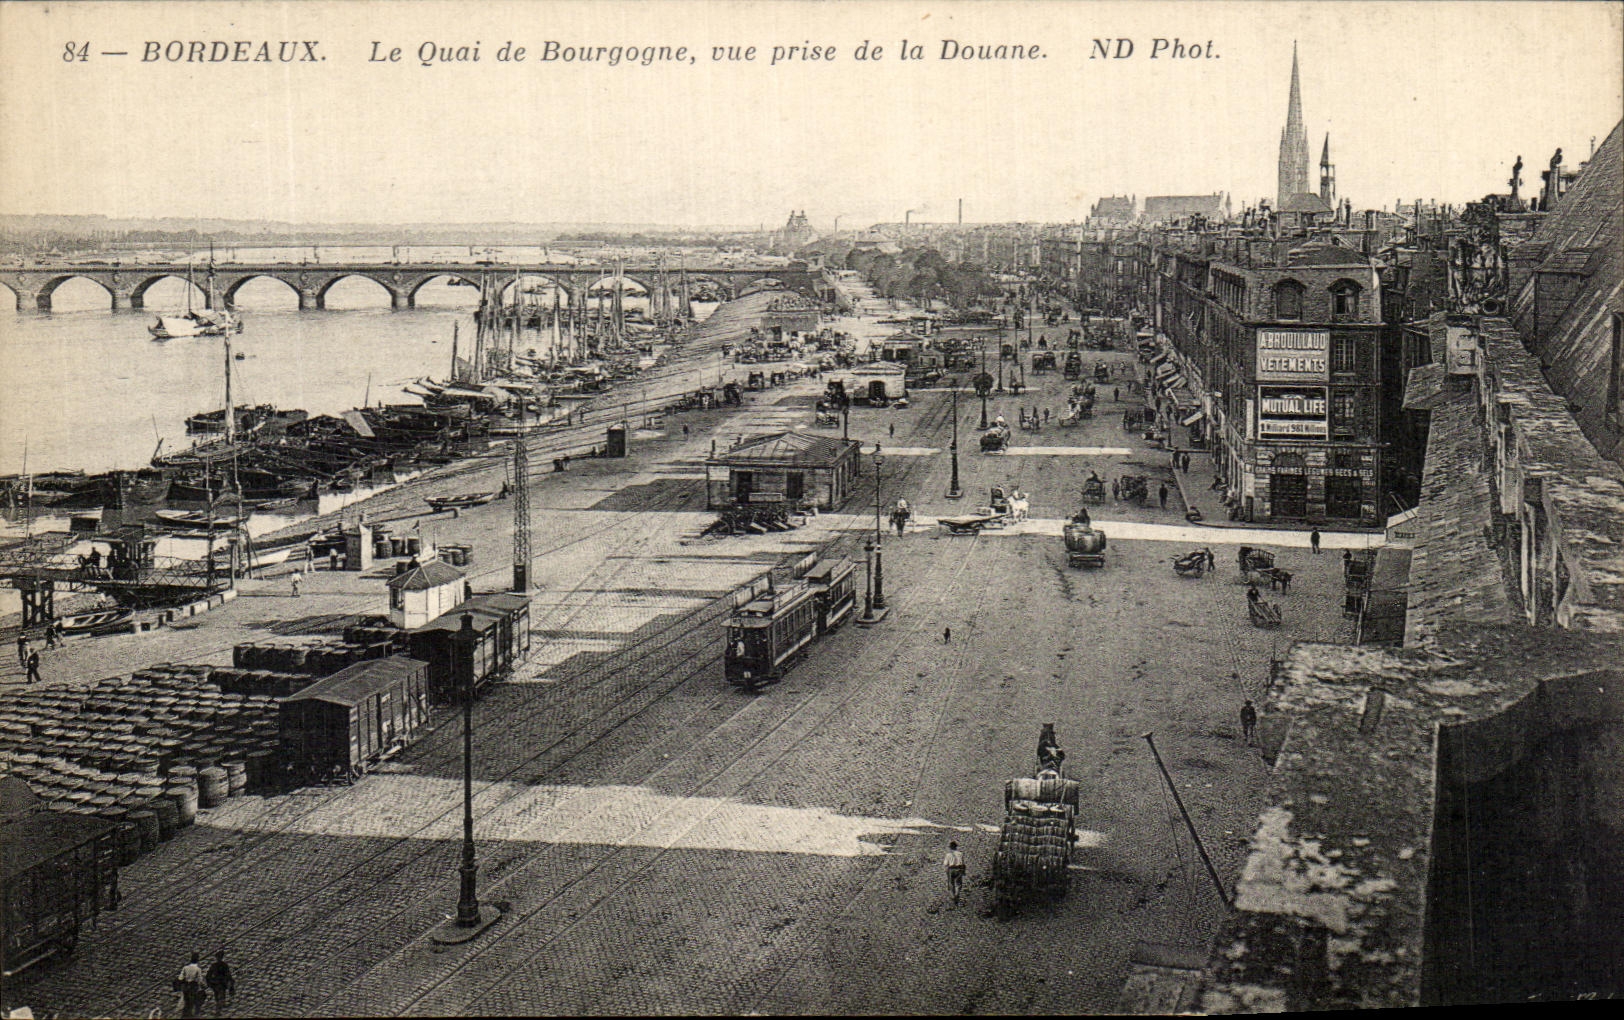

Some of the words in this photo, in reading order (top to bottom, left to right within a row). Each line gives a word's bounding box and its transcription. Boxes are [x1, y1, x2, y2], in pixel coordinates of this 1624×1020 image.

[1261, 358, 1326, 372] VETEMENTS
[1262, 399, 1301, 413] MUTUAL
[1303, 400, 1326, 414] LIFE
